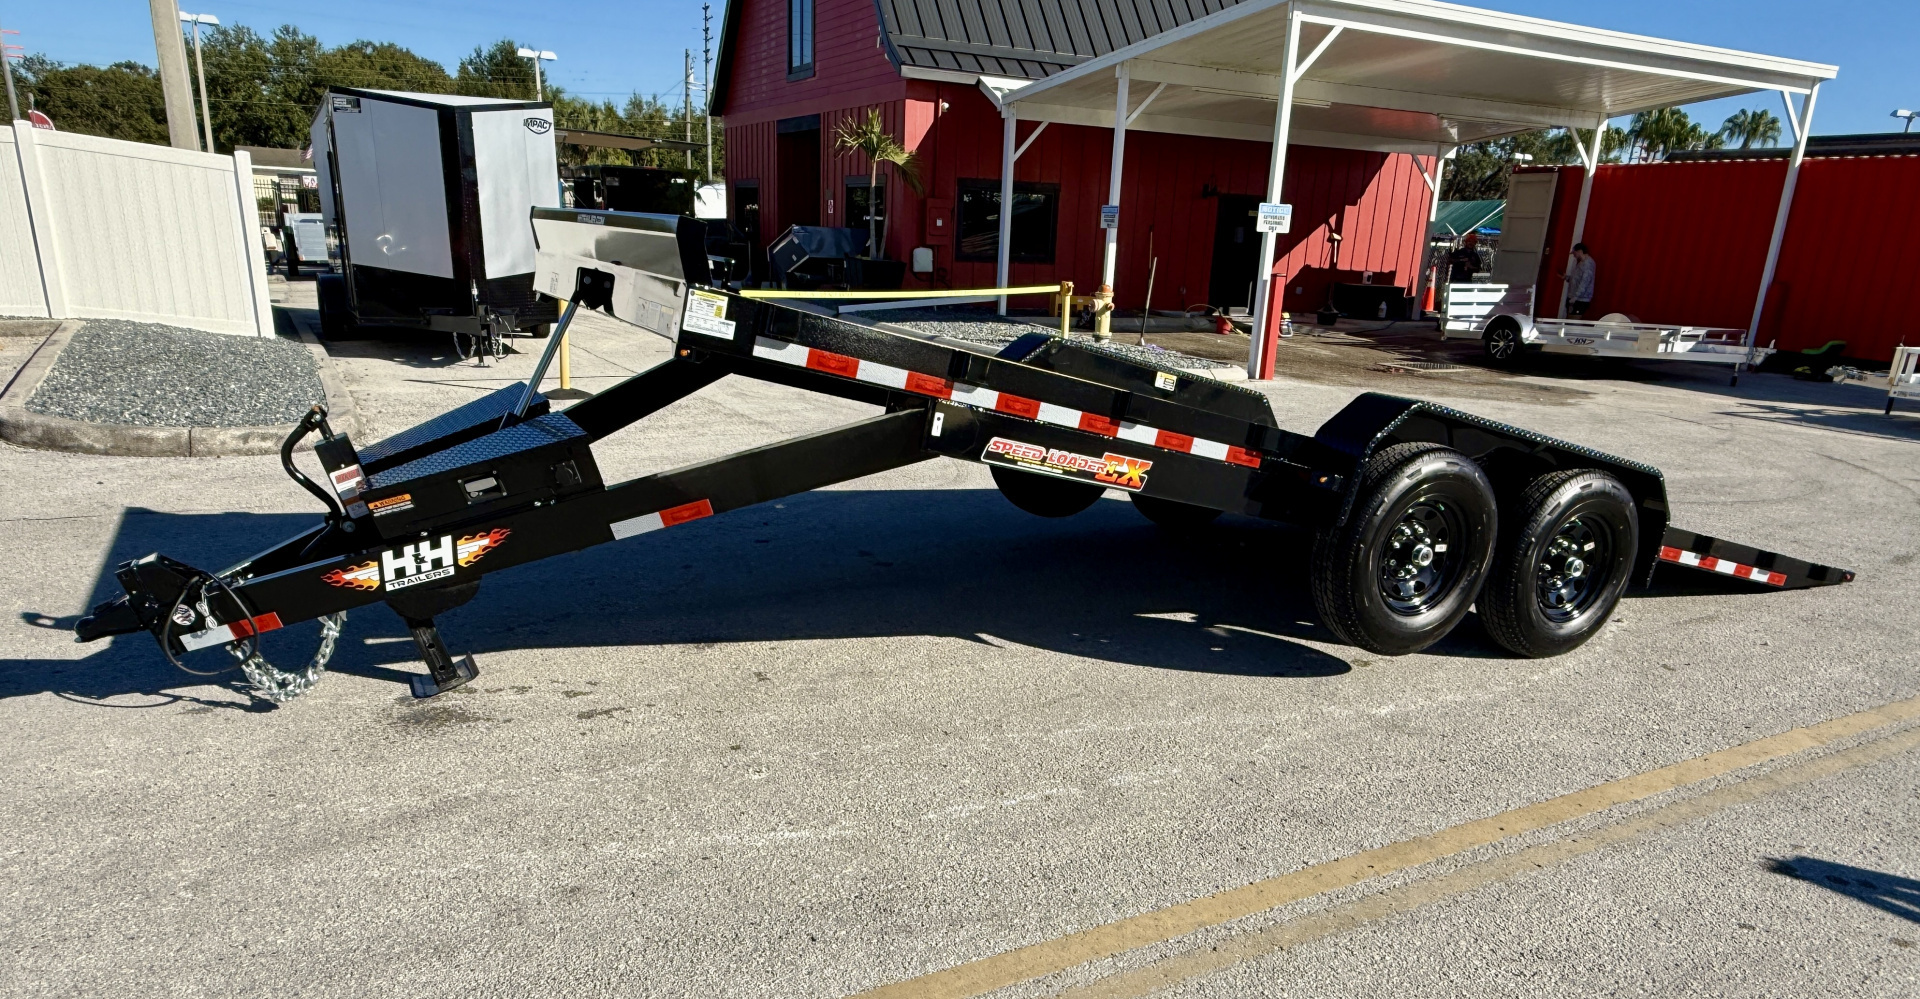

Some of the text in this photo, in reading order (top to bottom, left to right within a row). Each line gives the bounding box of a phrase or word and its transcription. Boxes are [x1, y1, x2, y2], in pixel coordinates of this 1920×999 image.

[989, 440, 1044, 460] SPEED
[1047, 449, 1109, 474] LOADER
[379, 495, 406, 507] WARNING
[381, 534, 454, 582] H&H
[388, 568, 451, 589] TRAILERS
